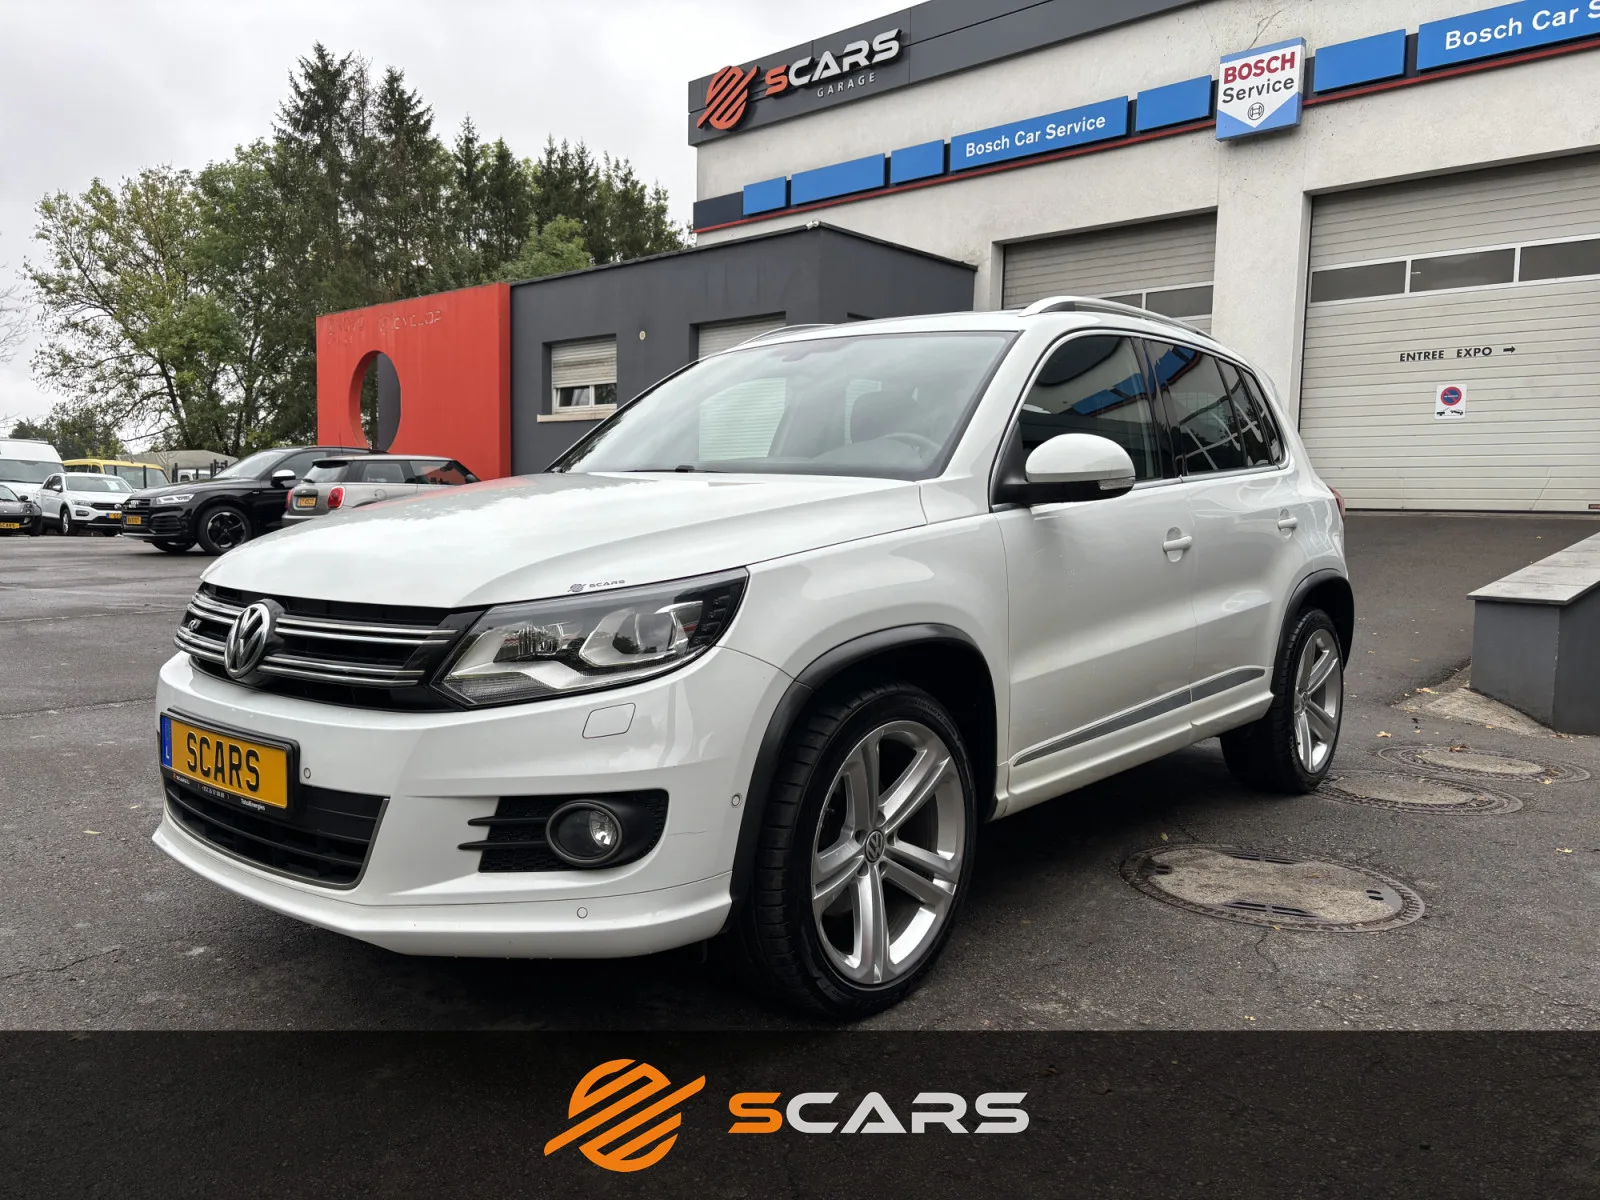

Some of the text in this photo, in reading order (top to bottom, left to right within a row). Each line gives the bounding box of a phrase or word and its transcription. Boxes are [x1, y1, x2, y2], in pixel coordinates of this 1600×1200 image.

[1445, 17, 1523, 50] Bosch
[1532, 8, 1579, 31] Car
[765, 28, 900, 96] SCARS
[1223, 51, 1295, 85] BOSCH
[817, 72, 876, 98] GARAGE
[1222, 77, 1295, 104] Service
[965, 116, 1106, 157] Bosch Car Service
[1399, 346, 1493, 362] ENTREE EXPO
[589, 579, 625, 588] SCARS
[186, 730, 260, 792] SCARS
